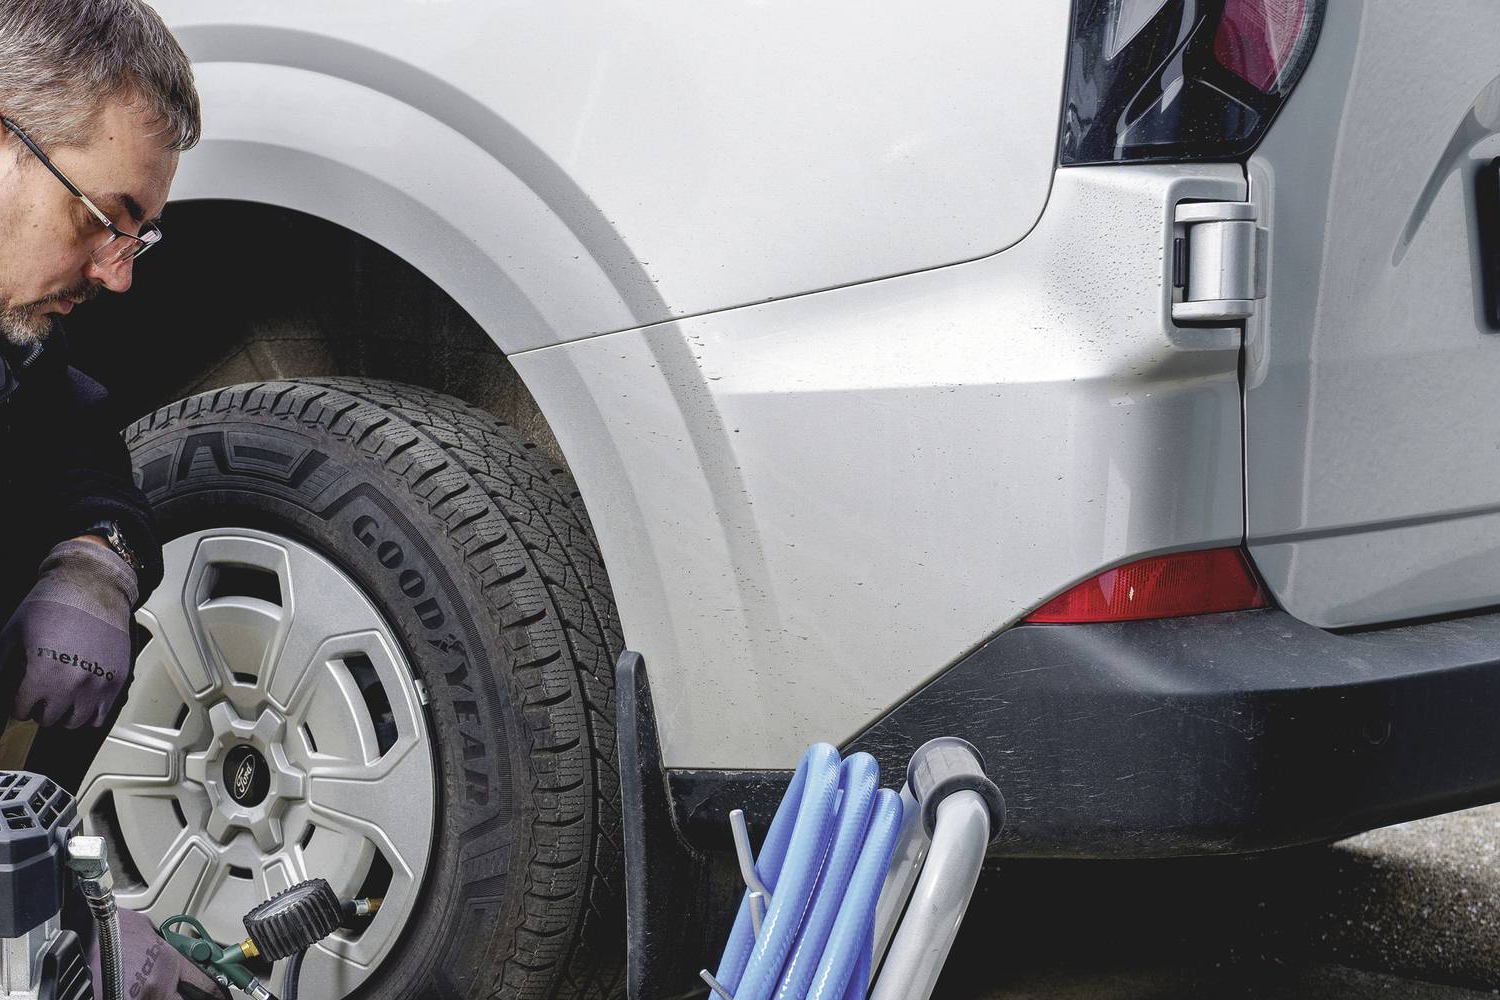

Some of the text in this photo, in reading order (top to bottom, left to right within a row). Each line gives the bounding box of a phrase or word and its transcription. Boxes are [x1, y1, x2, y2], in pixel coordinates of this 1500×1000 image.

[37, 647, 114, 681] metabo
[353, 515, 489, 806] GOODYEAR
[236, 760, 253, 794] Ford
